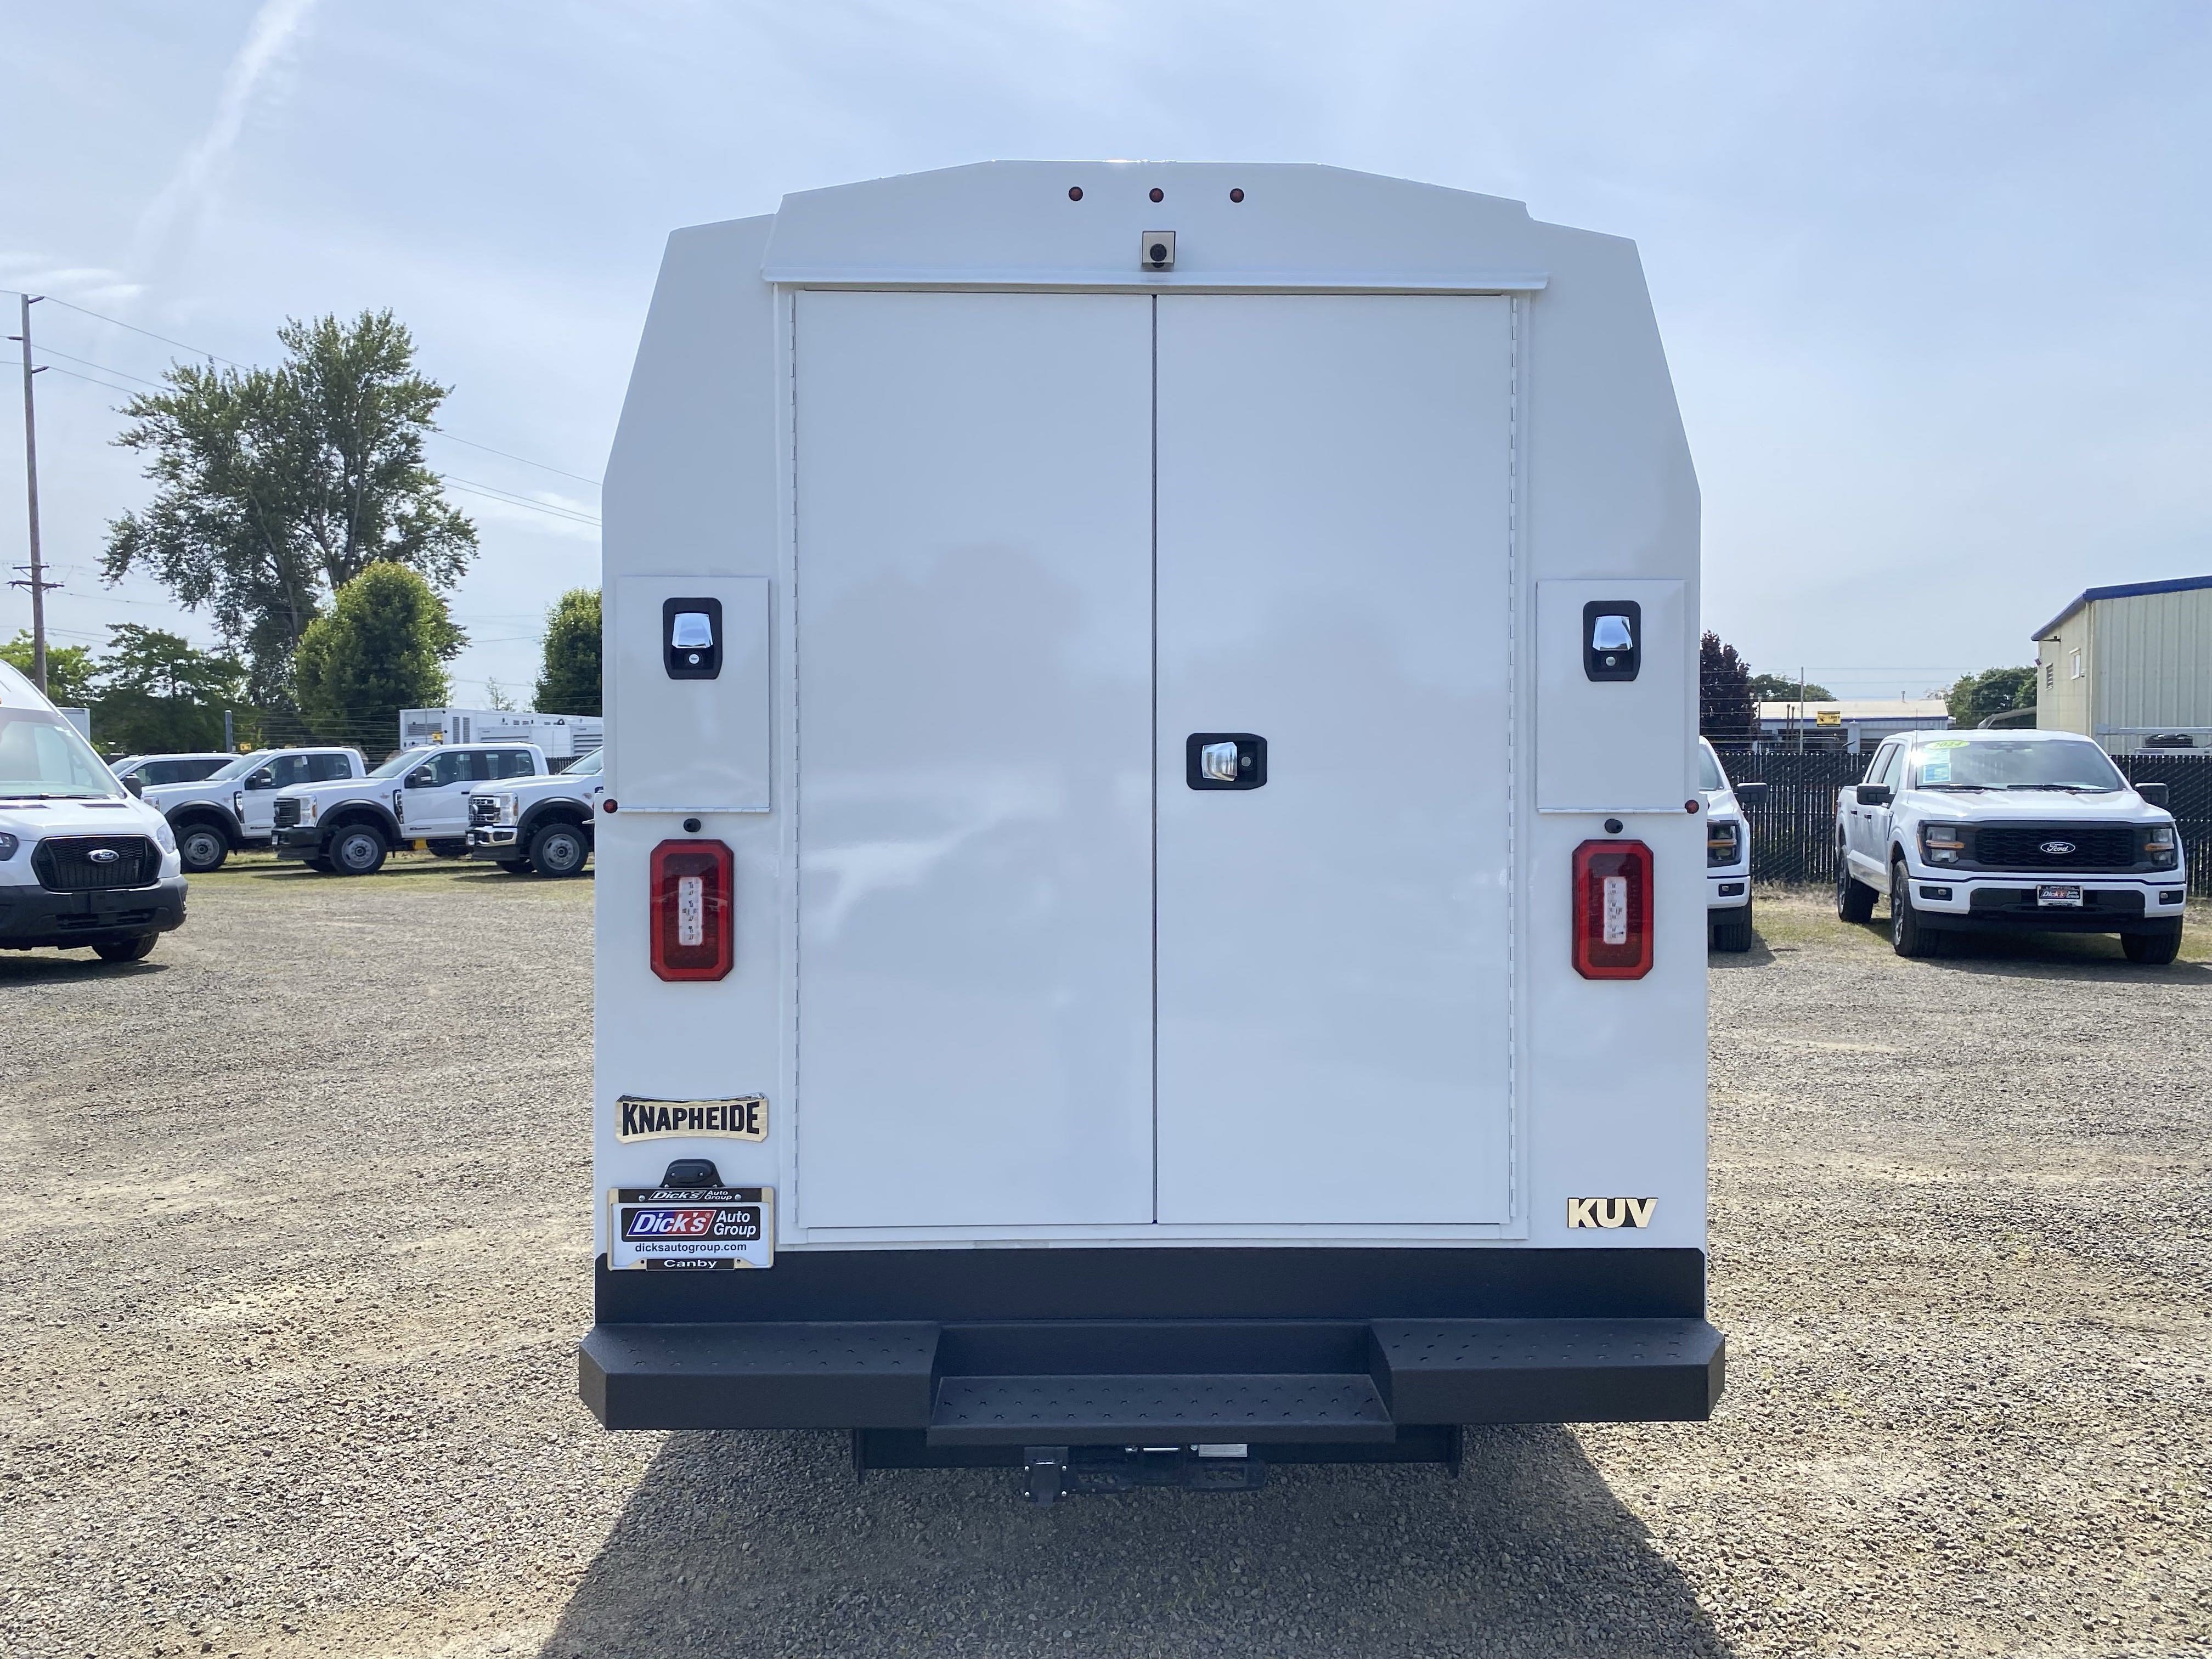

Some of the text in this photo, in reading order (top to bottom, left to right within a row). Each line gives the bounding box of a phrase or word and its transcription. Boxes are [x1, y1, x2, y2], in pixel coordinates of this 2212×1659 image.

[2047, 843, 2068, 851] Ford
[623, 1101, 760, 1136] KNAPHEIDE
[653, 1190, 701, 1199] Dick's
[716, 1210, 751, 1223] Auto
[1567, 1198, 1658, 1228] KUV
[632, 1212, 707, 1233] Dick's
[714, 1223, 757, 1237] Group
[635, 1243, 747, 1254] dicksautogroup.com
[664, 1260, 717, 1268] Canby
